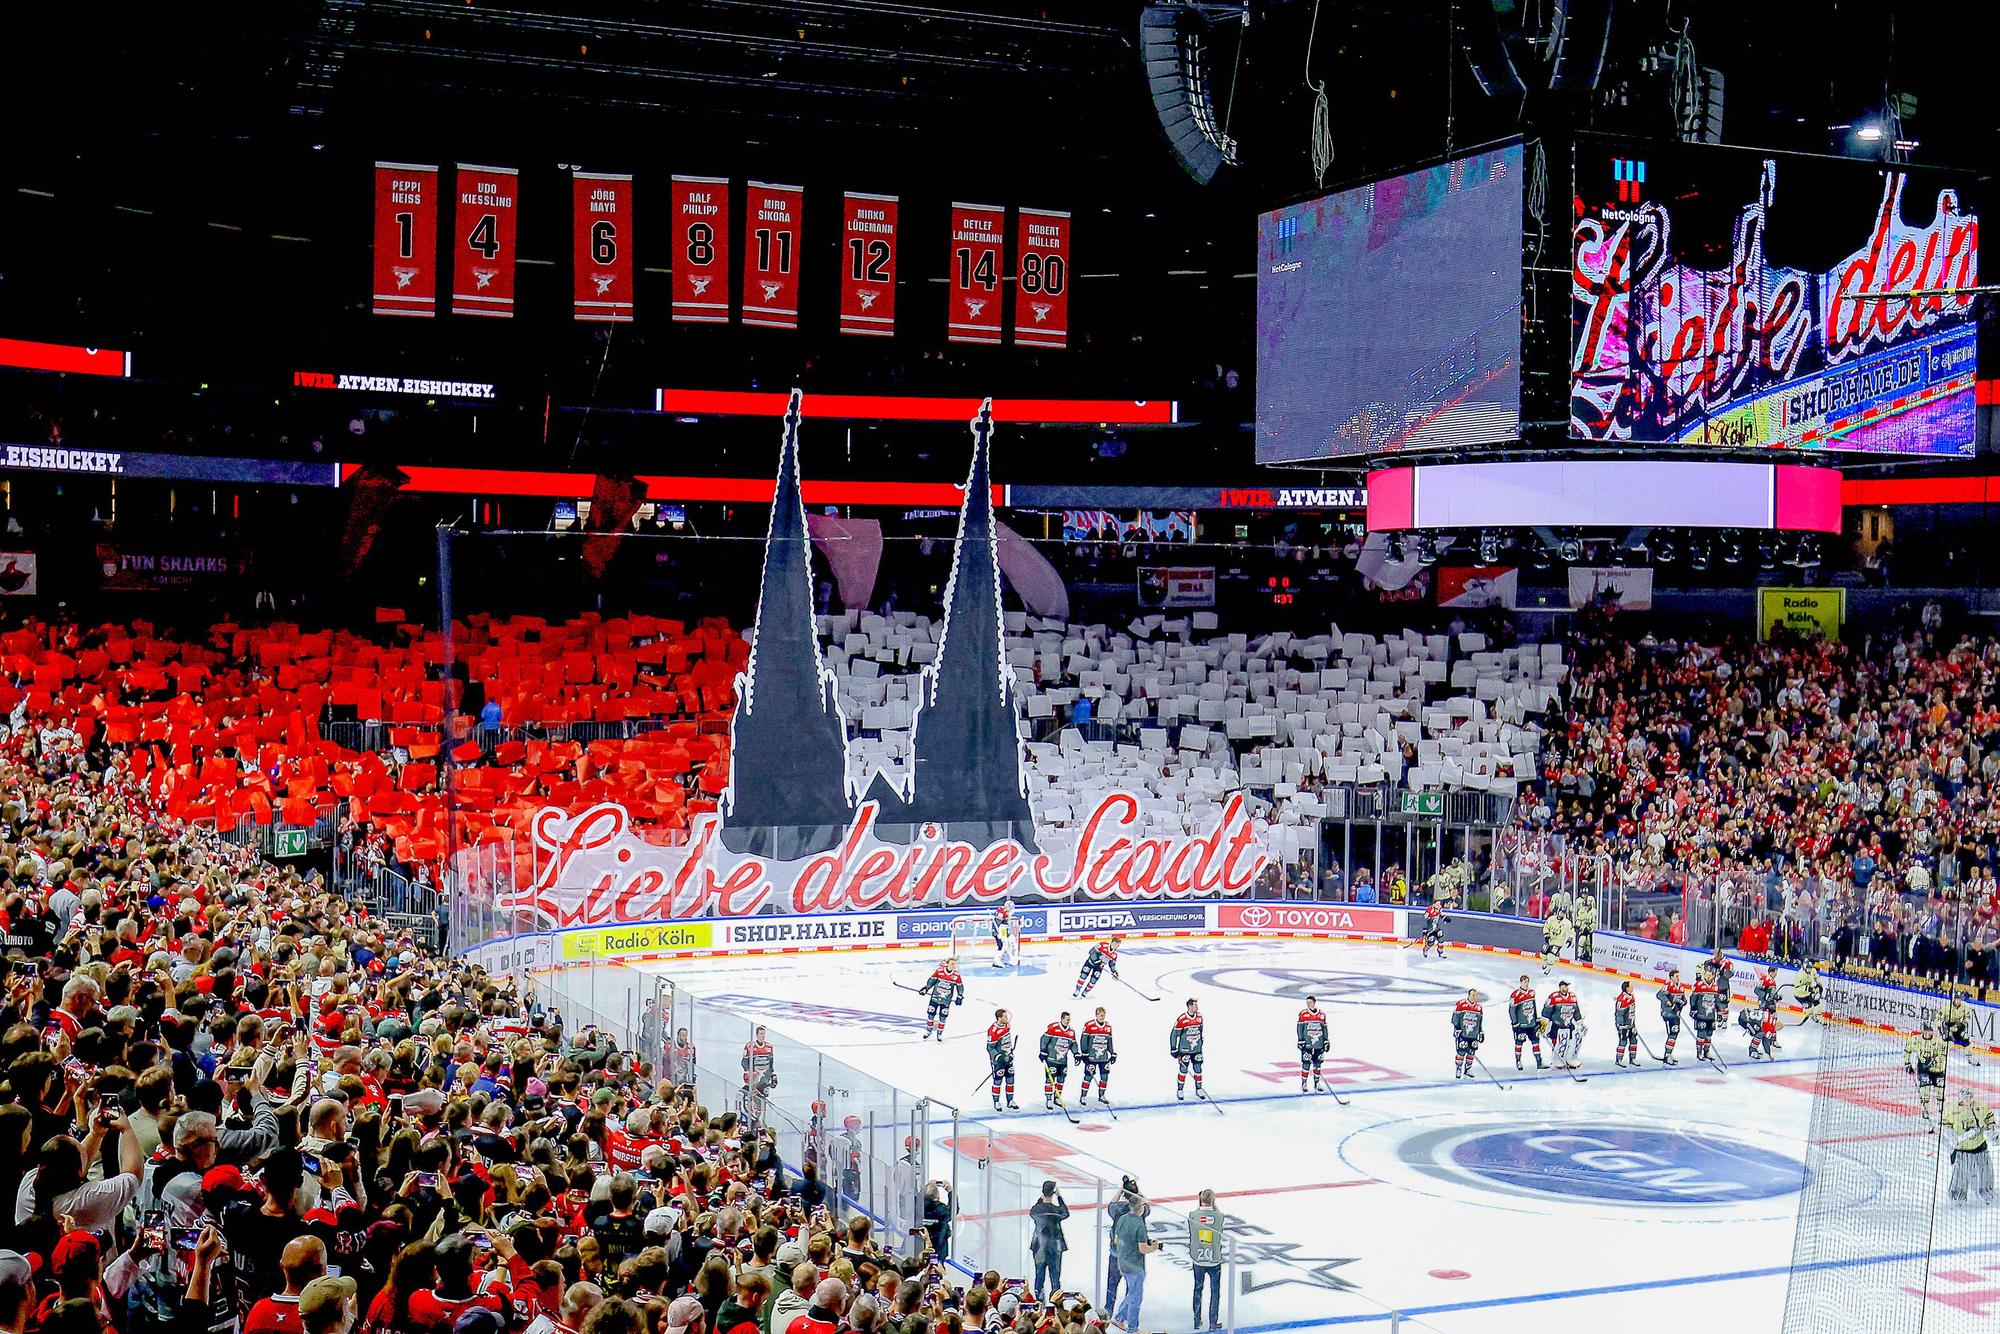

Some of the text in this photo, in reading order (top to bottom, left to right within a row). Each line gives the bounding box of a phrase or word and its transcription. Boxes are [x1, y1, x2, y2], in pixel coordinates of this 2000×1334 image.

[392, 181, 421, 193] PEPPI
[478, 183, 497, 194] UDO
[392, 193, 421, 205] HEISS
[462, 194, 512, 208] KIESSLING
[591, 188, 615, 201] JÖRG
[689, 192, 712, 204] RALF
[590, 201, 616, 214] MAYR
[682, 203, 719, 215] PHILIPP
[763, 199, 786, 211] MIRO
[758, 210, 791, 223] SIKORA
[857, 209, 885, 221] MIRKO
[1601, 208, 1656, 224] NetCologne
[848, 220, 894, 234] LÜDEMANN
[963, 219, 993, 231] DETLEF
[1028, 224, 1060, 237] ROBERT
[395, 212, 413, 259] 1
[467, 214, 500, 260] 4
[590, 220, 617, 265] 6
[953, 230, 1003, 244] LANGEMANN
[1028, 235, 1060, 249] MÜLLER
[686, 221, 715, 266] 8
[755, 228, 792, 274] 11
[849, 238, 891, 283] 12
[957, 247, 998, 292] 14
[1021, 252, 1065, 296] 80
[1789, 357, 1921, 424] SHOP.HAIE.DE
[0, 446, 123, 472] .EISHOCKEY.
[1784, 597, 1818, 608] Radio
[1787, 611, 1814, 622] Köln
[501, 791, 1267, 928] Liebe deine Stadt
[1060, 911, 1136, 929] EUROPA
[1138, 914, 1187, 922] VERSICHERUNG
[1276, 910, 1353, 928] TOYOTA
[734, 920, 885, 943] SHOP.HAIE.DE
[605, 932, 649, 950] Radio
[658, 930, 695, 946] Köln
[1611, 951, 1649, 963] HOCKEY
[1525, 1135, 1750, 1195] CGM
